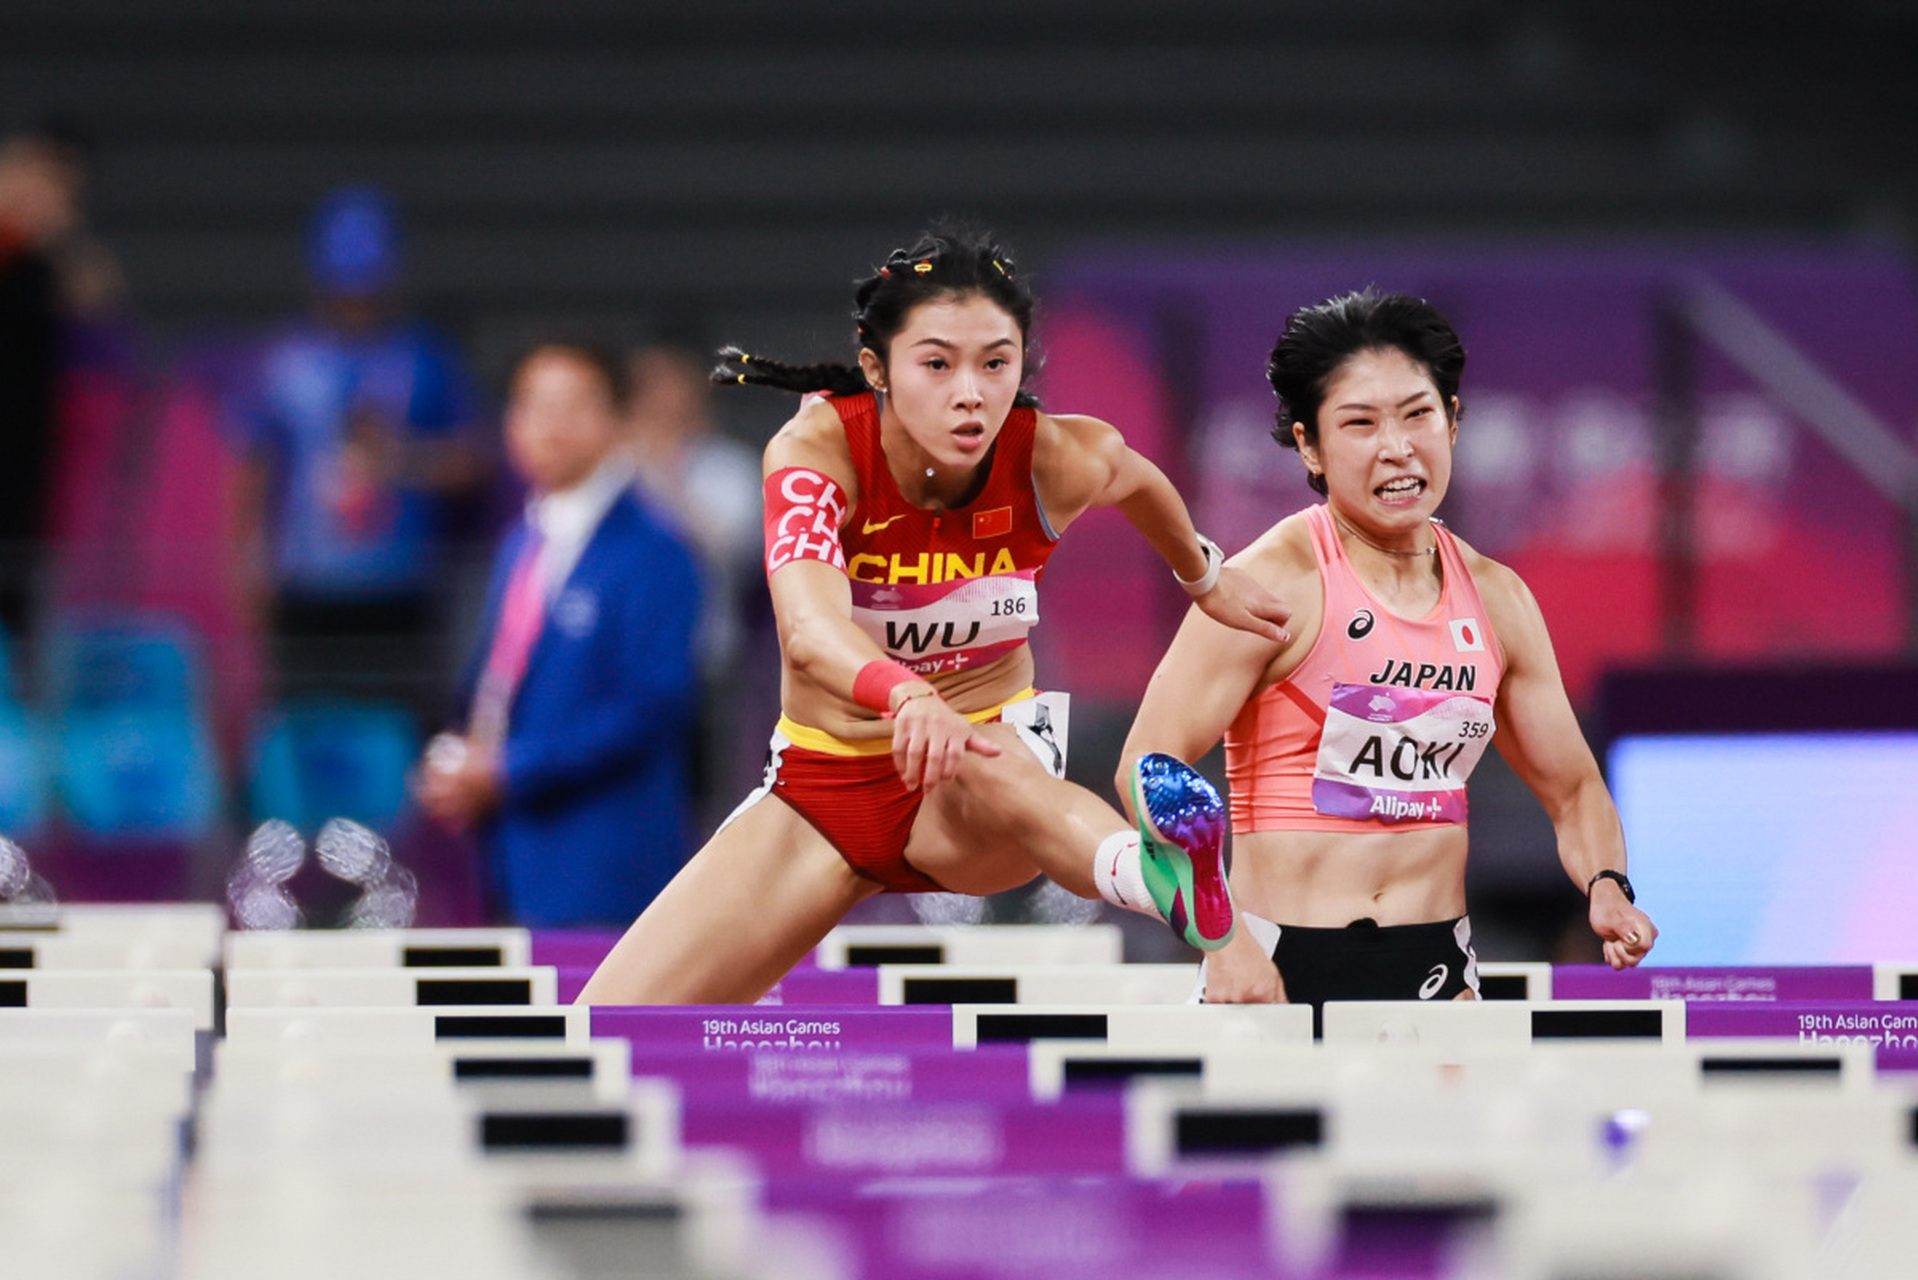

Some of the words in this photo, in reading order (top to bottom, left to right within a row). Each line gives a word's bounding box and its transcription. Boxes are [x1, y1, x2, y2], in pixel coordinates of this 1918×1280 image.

[849, 547, 1017, 585] CHINA
[990, 597, 1026, 616] 186
[885, 621, 981, 653] WU
[1371, 660, 1475, 691] JAPAN
[1458, 721, 1489, 738] 359
[1348, 735, 1466, 781] AOKI
[702, 1020, 737, 1034] 19th
[740, 1020, 784, 1034] Asian
[786, 1020, 841, 1034] Games
[1798, 1014, 1833, 1030] 19th
[1835, 1014, 1879, 1030] Asian
